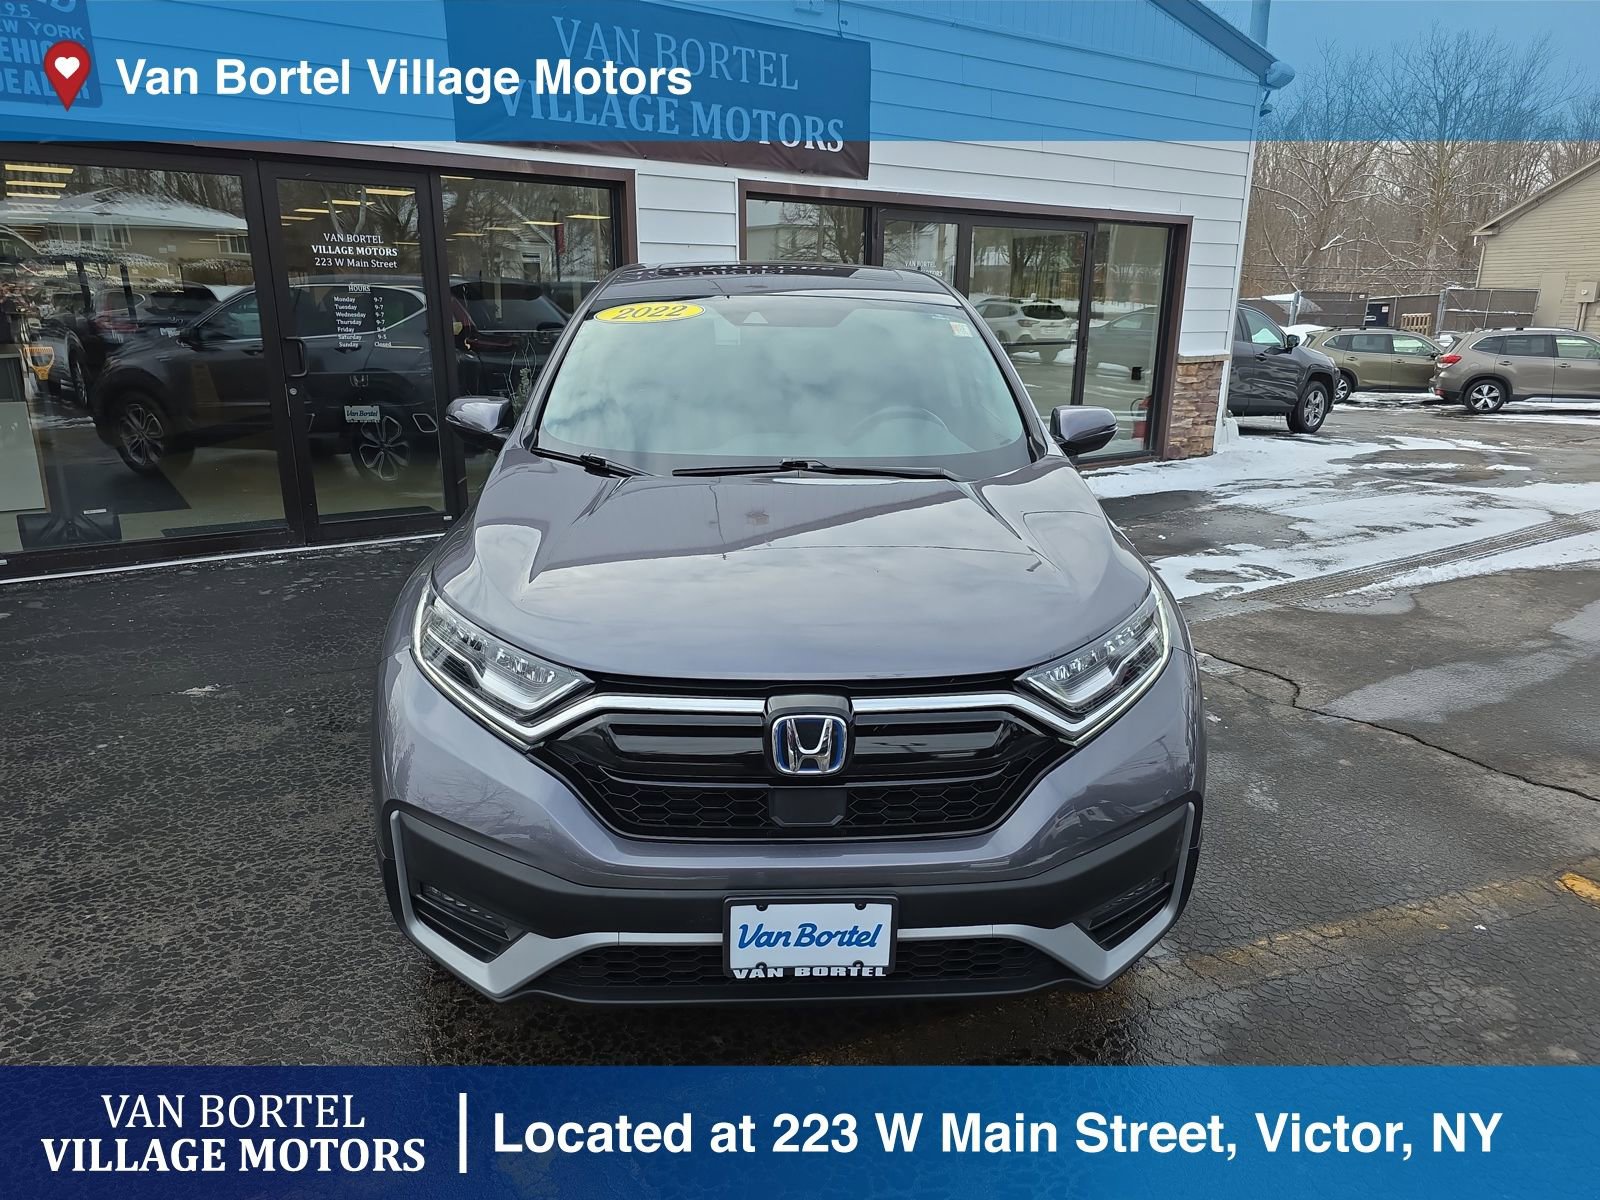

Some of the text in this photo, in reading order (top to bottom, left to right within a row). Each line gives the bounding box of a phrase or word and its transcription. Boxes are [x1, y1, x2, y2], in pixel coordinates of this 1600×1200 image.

[26, 21, 85, 41] YORK
[551, 15, 799, 91] VAN BORTEL
[690, 101, 845, 153] MOTORS
[323, 233, 384, 244] VAN BORTEL
[311, 245, 398, 257] VILLAGE MOTORS
[315, 258, 398, 269] 223 W Main Street
[348, 284, 371, 292] HOURS
[612, 305, 688, 320] 2022
[738, 922, 883, 949] Van Bortel
[733, 966, 887, 979] VAN BORTEL
